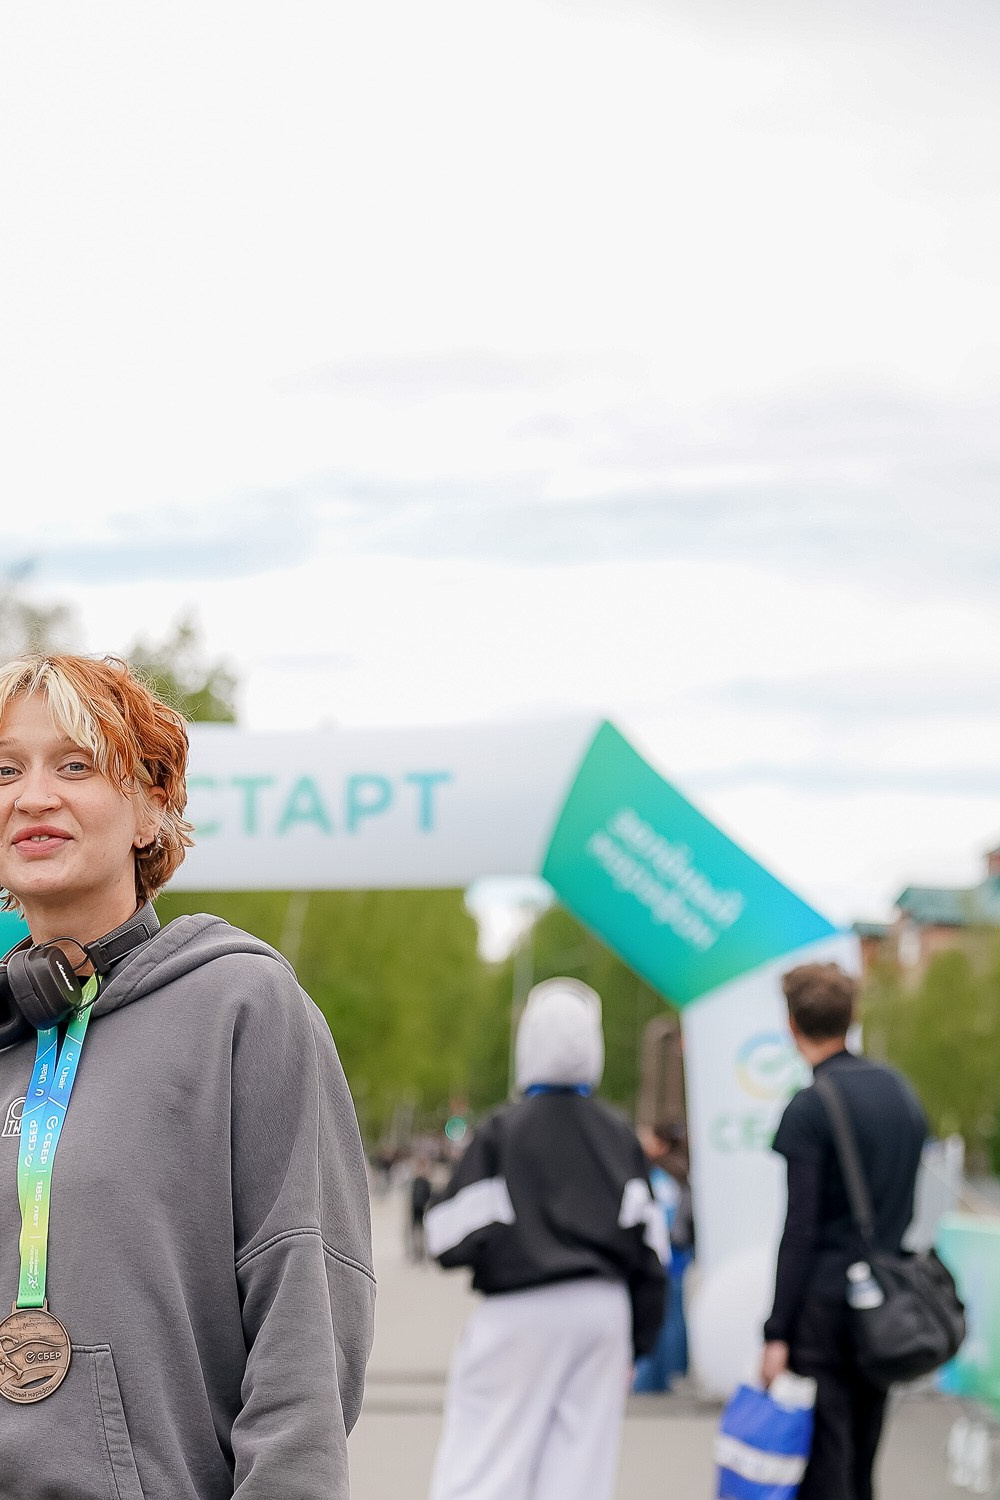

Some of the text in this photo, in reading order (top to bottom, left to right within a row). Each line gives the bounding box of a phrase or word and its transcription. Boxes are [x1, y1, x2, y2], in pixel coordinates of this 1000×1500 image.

[28, 1119, 39, 1151] СБЕР
[40, 1132, 53, 1165] СБЕР
[34, 1180, 44, 1201] 185
[37, 1351, 62, 1361] СБЕР
